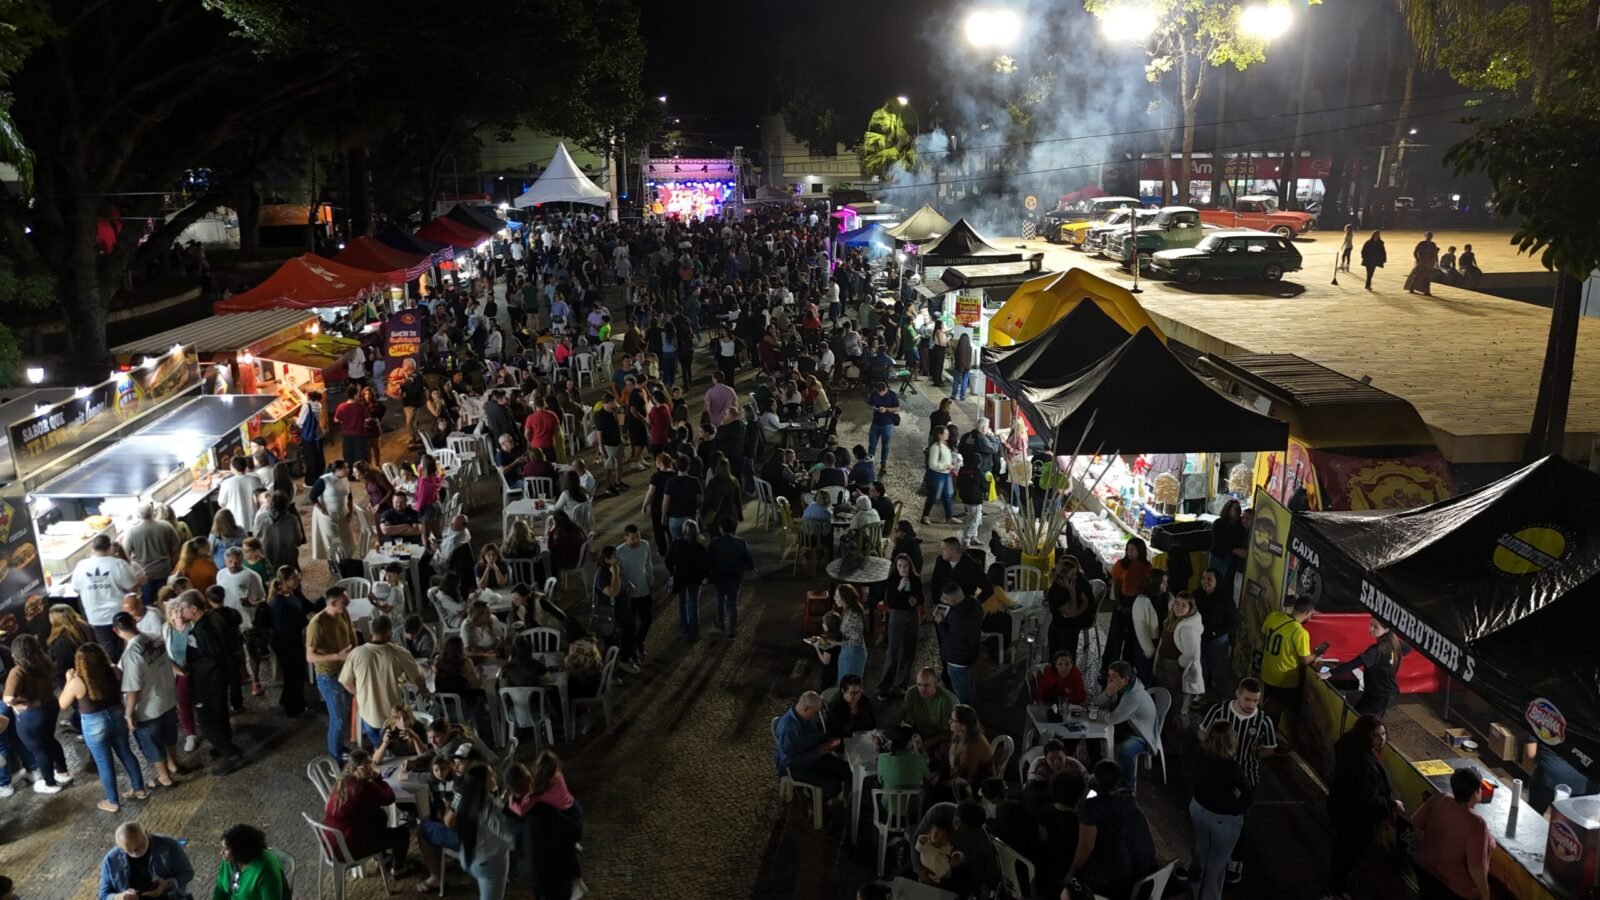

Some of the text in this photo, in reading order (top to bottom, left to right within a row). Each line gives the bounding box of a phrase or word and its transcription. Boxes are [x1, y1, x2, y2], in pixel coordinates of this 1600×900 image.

[22, 411, 67, 443] SABOR QUE
[1292, 536, 1320, 568] CAIXA
[1266, 628, 1283, 657] 10
[1529, 705, 1561, 733] BRAHMA
